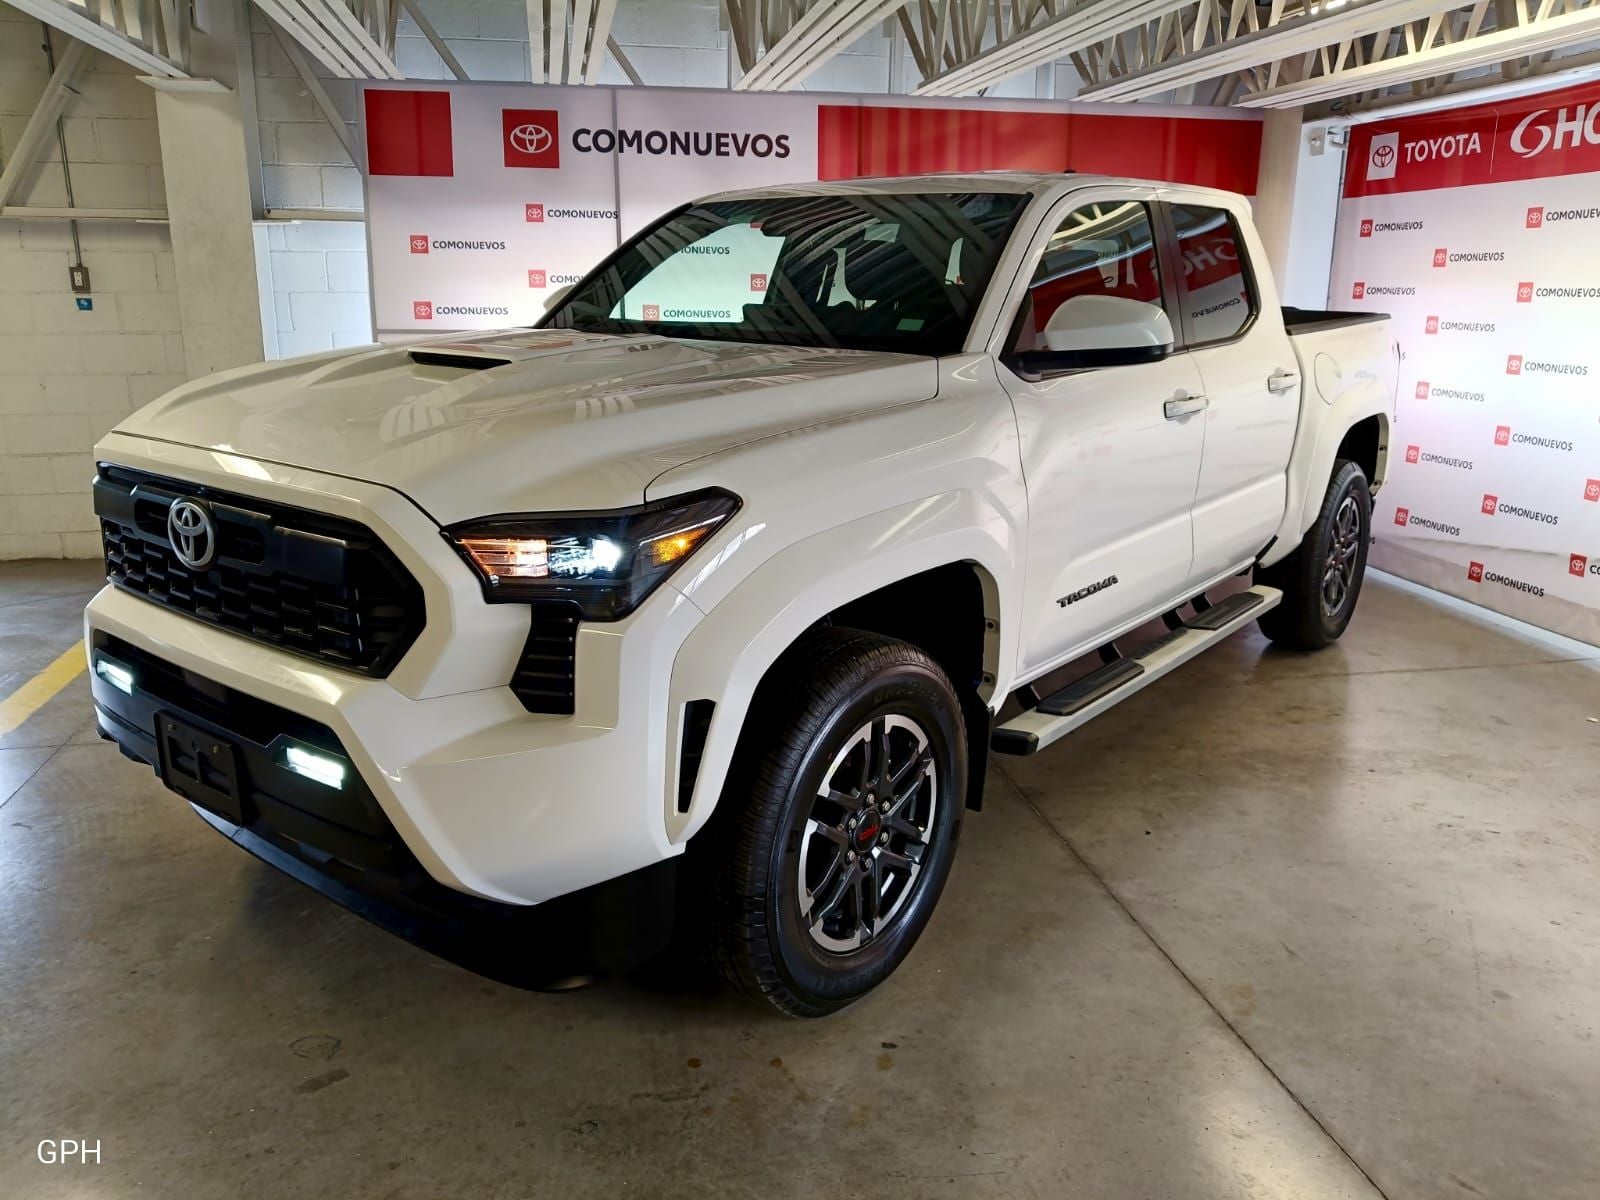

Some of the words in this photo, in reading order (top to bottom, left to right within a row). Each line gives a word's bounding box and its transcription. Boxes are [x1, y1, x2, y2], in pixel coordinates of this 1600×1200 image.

[572, 128, 790, 159] COMONUEVOS
[1404, 132, 1481, 164] TOYOTA
[547, 209, 619, 219] COMONUEVOS
[1374, 221, 1423, 232] COMONUEVOS
[432, 240, 506, 250] COMONUEVOS
[1449, 252, 1505, 262] COMONUEVOS
[1366, 286, 1416, 296] COMONUEVOS
[436, 306, 509, 316] COMONUEVOS
[663, 309, 731, 319] COMONUEVOS
[1440, 321, 1496, 333] COMONUEVOS
[1524, 361, 1588, 376] COMONUEVOS
[1431, 387, 1485, 402] COMONUEVOS
[1512, 433, 1573, 452] COMONUEVOS
[1420, 452, 1473, 470] COMONUEVOS
[1498, 503, 1558, 526] COMONUEVOS
[1409, 515, 1460, 537] COMONUEVOS
[1056, 575, 1118, 608] TACOMA
[1484, 571, 1545, 598] COMONUEVOS
